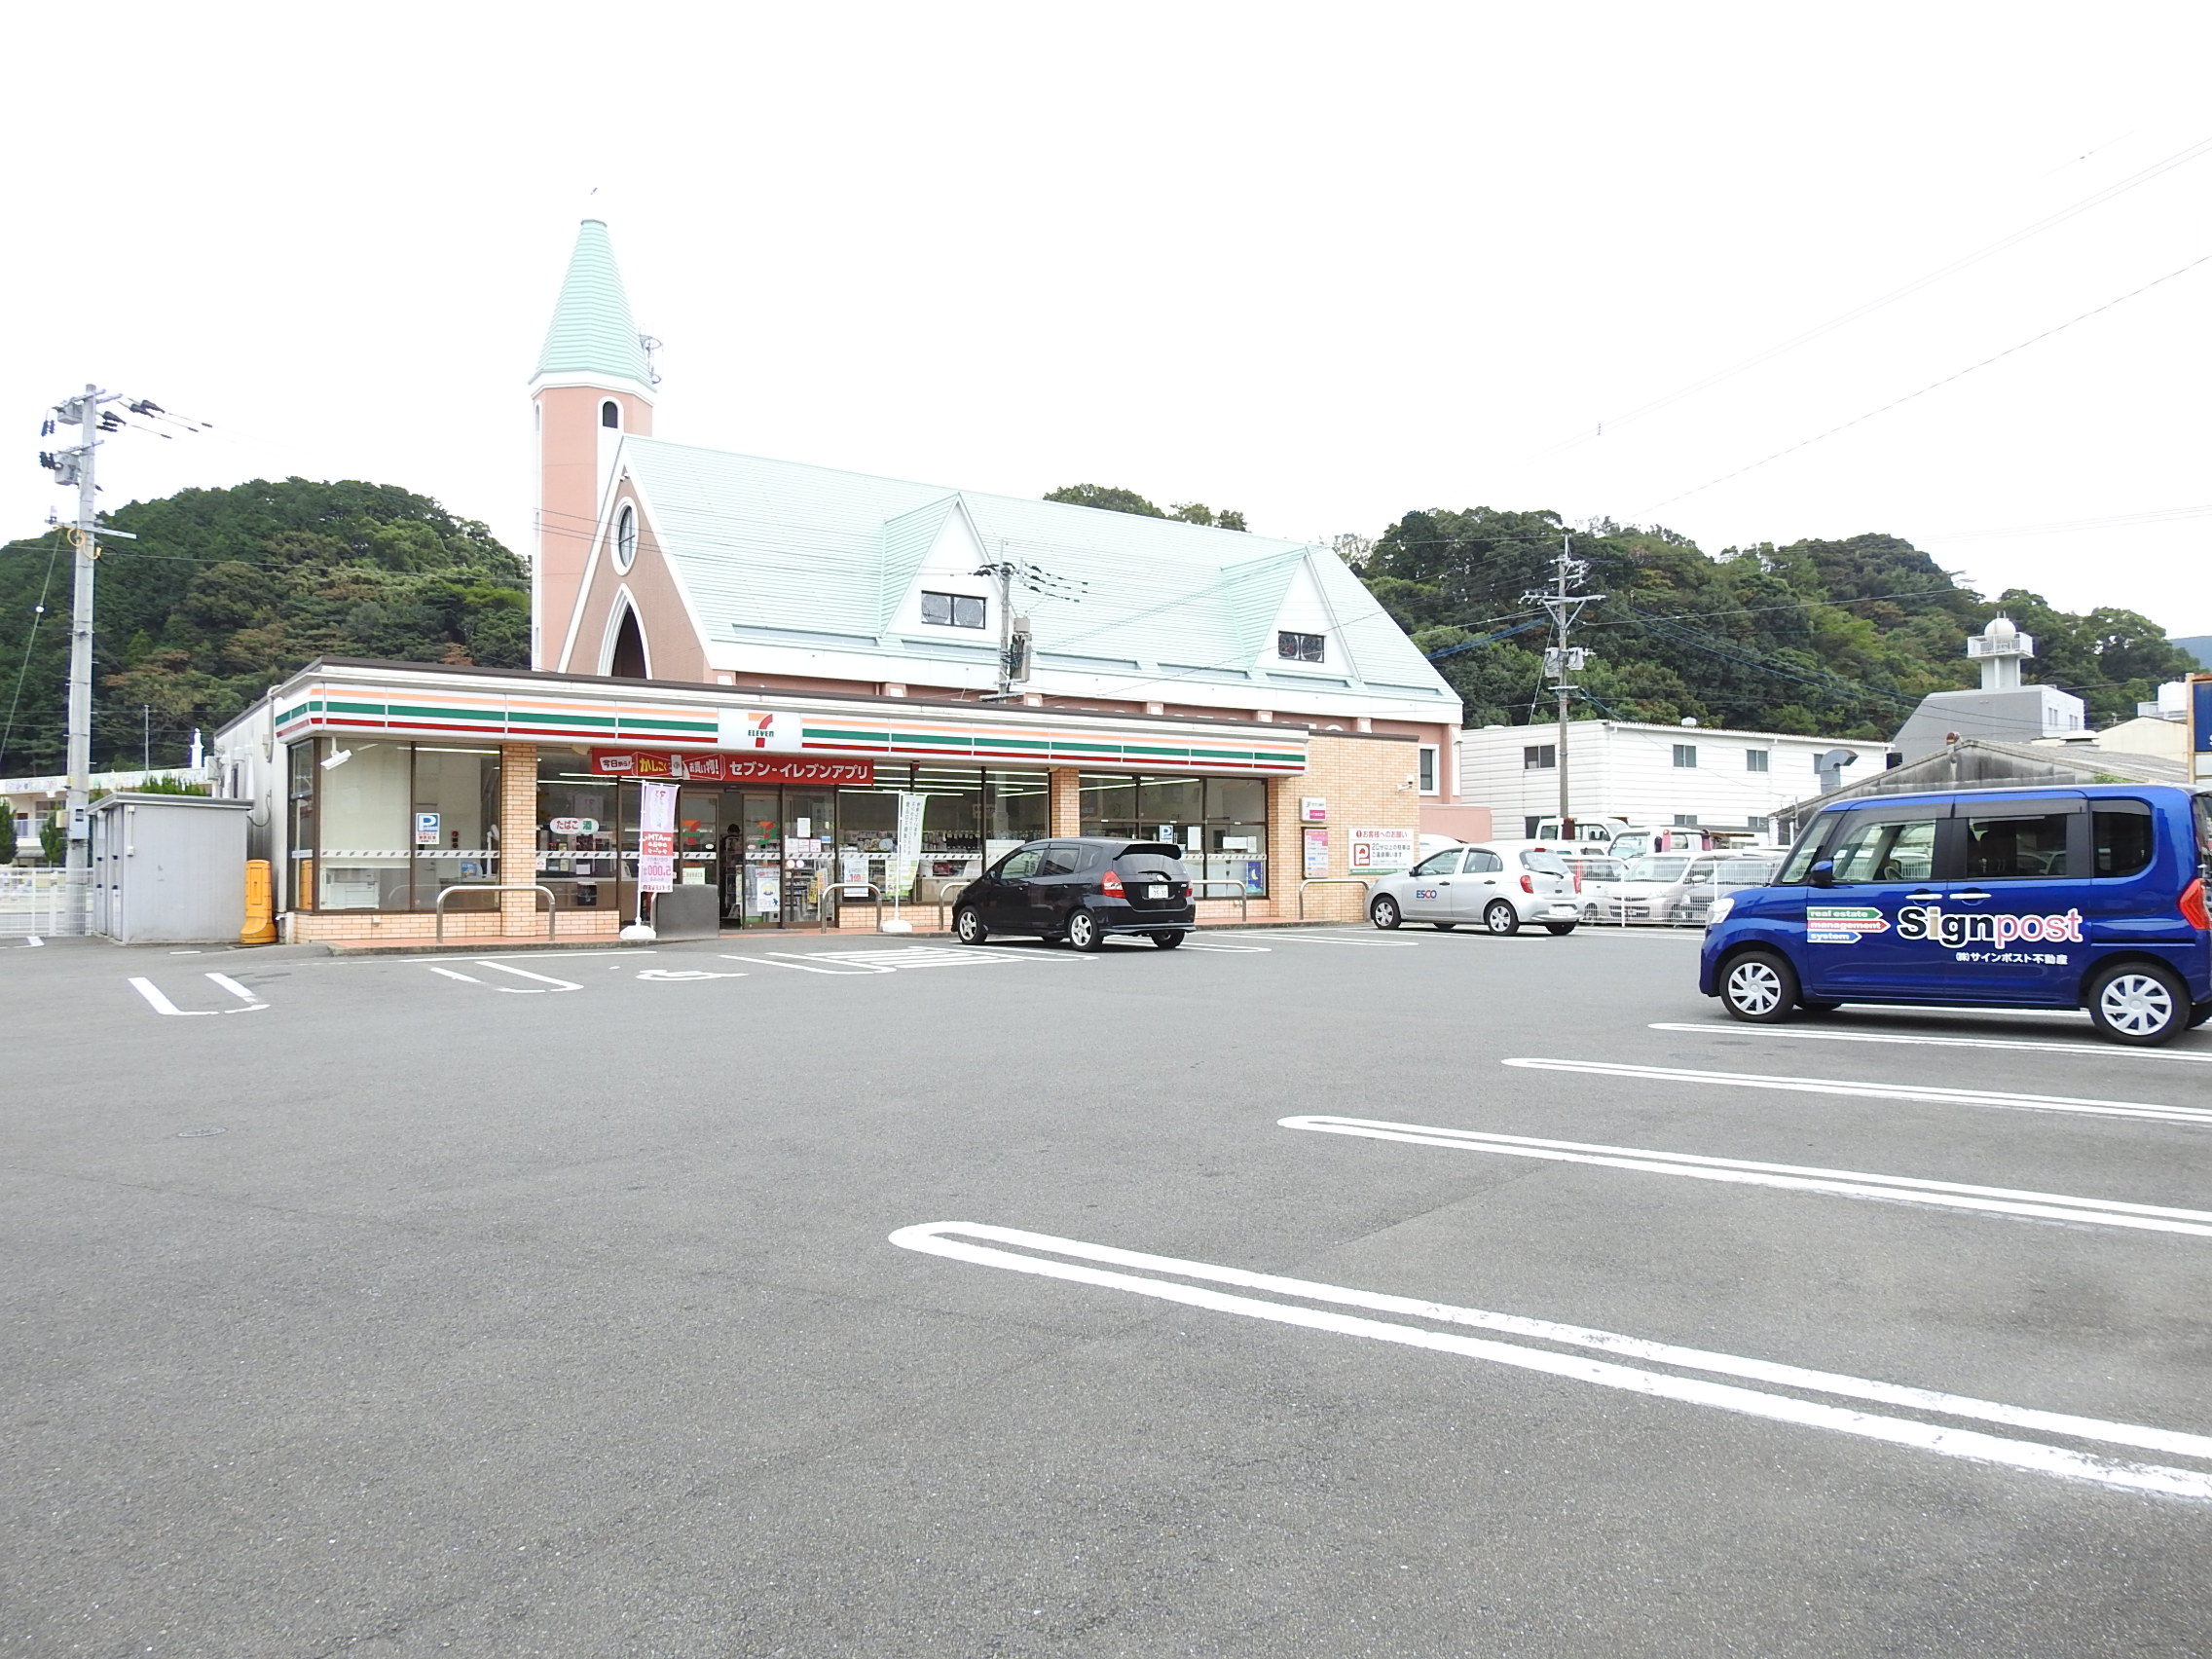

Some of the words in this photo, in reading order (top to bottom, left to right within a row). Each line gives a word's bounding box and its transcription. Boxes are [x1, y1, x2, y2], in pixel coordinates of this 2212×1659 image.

[419, 815, 436, 831] P
[556, 820, 578, 830] たばこ
[1416, 890, 1437, 899] ESCO
[1899, 907, 2082, 948] Signpost
[1810, 933, 1850, 941] system
